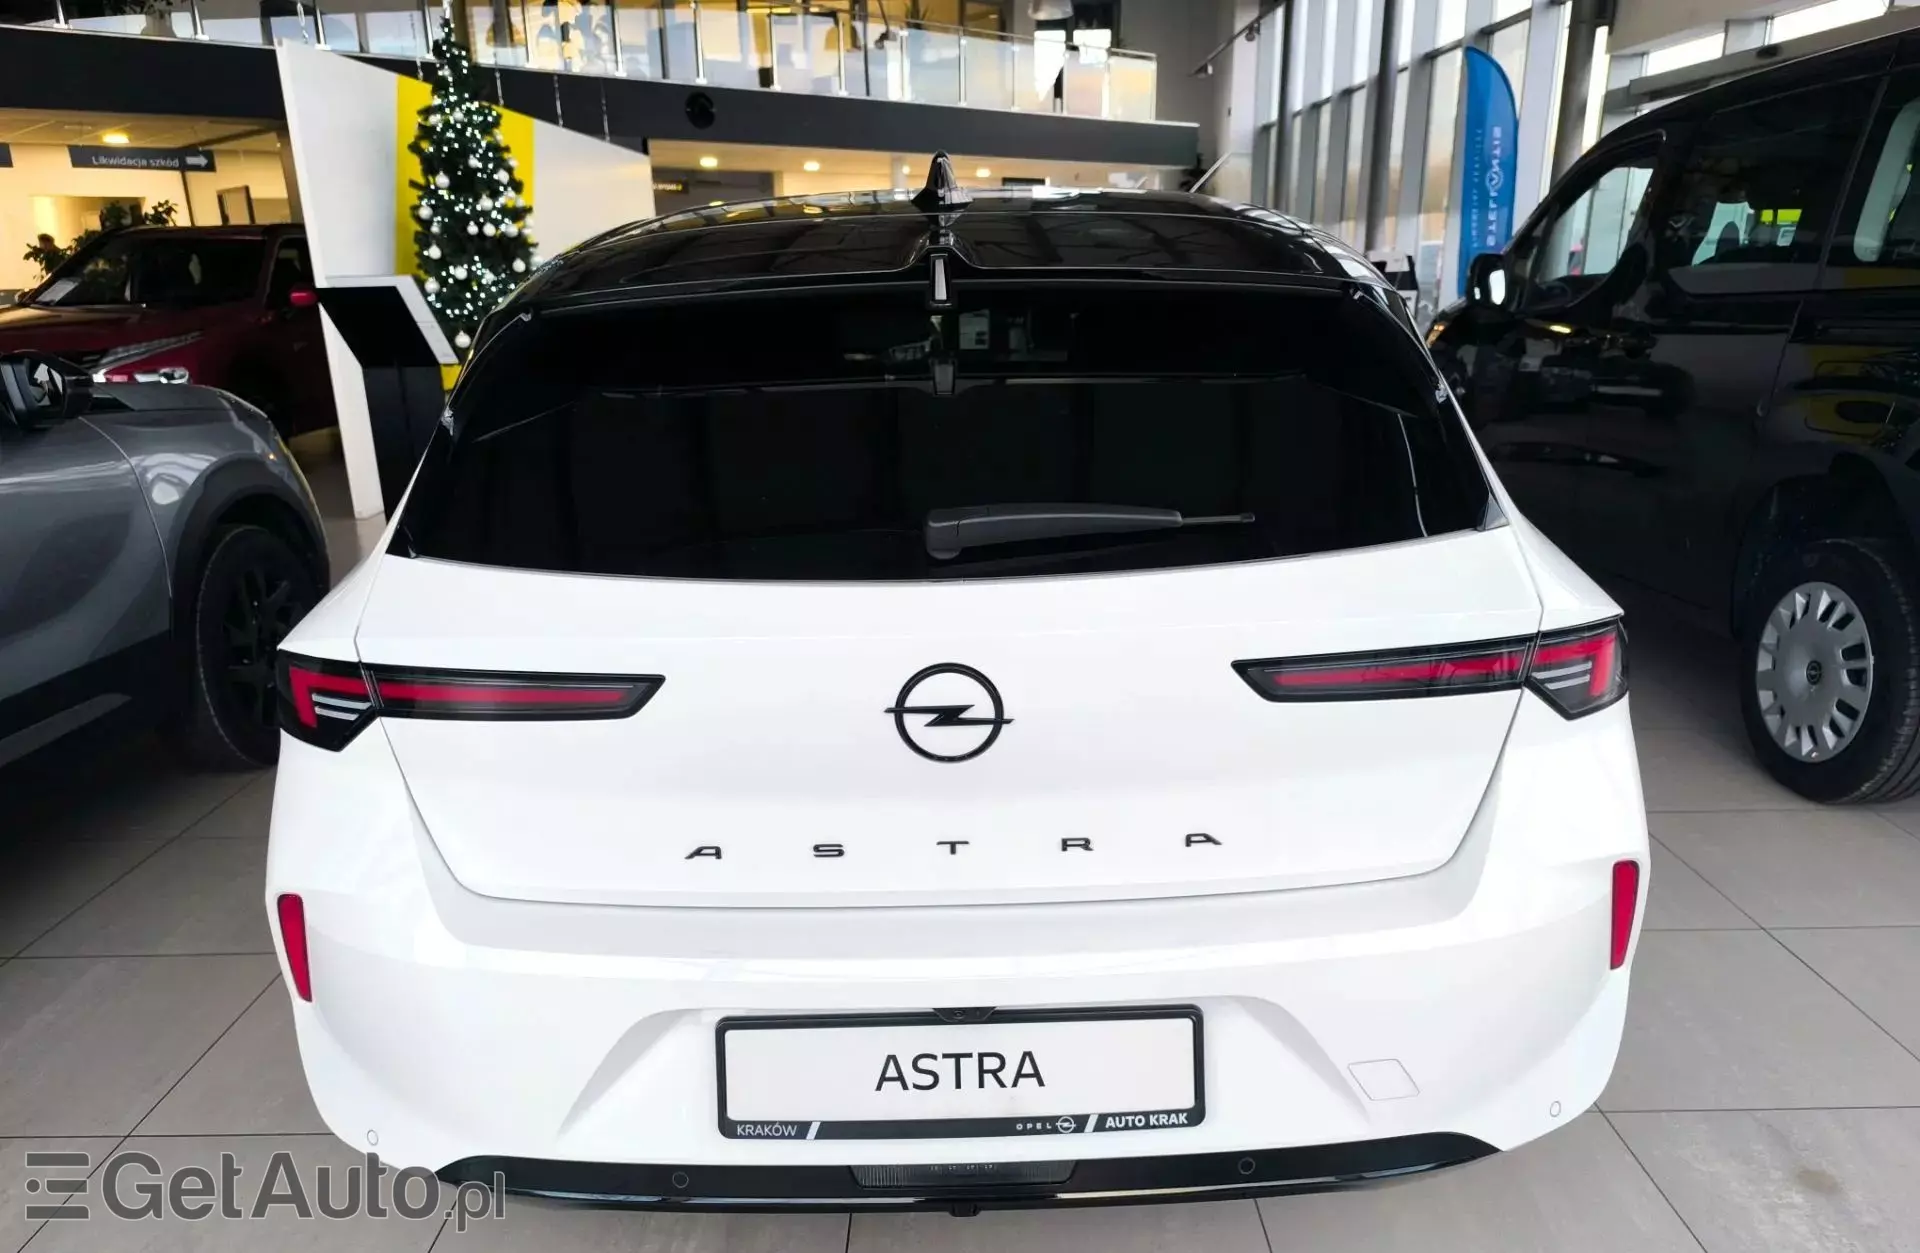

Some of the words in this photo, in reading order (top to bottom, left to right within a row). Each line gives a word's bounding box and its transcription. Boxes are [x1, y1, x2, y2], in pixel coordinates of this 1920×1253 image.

[91, 156, 147, 168] Likwidacja
[149, 157, 180, 168] szkód
[684, 832, 1223, 860] ASTRA
[875, 1050, 1046, 1092] ASTRA
[1015, 1123, 1052, 1131] OPEL
[1105, 1115, 1146, 1129] AUTO
[1149, 1112, 1188, 1127] KRAK
[736, 1121, 798, 1137] KRAKÓW
